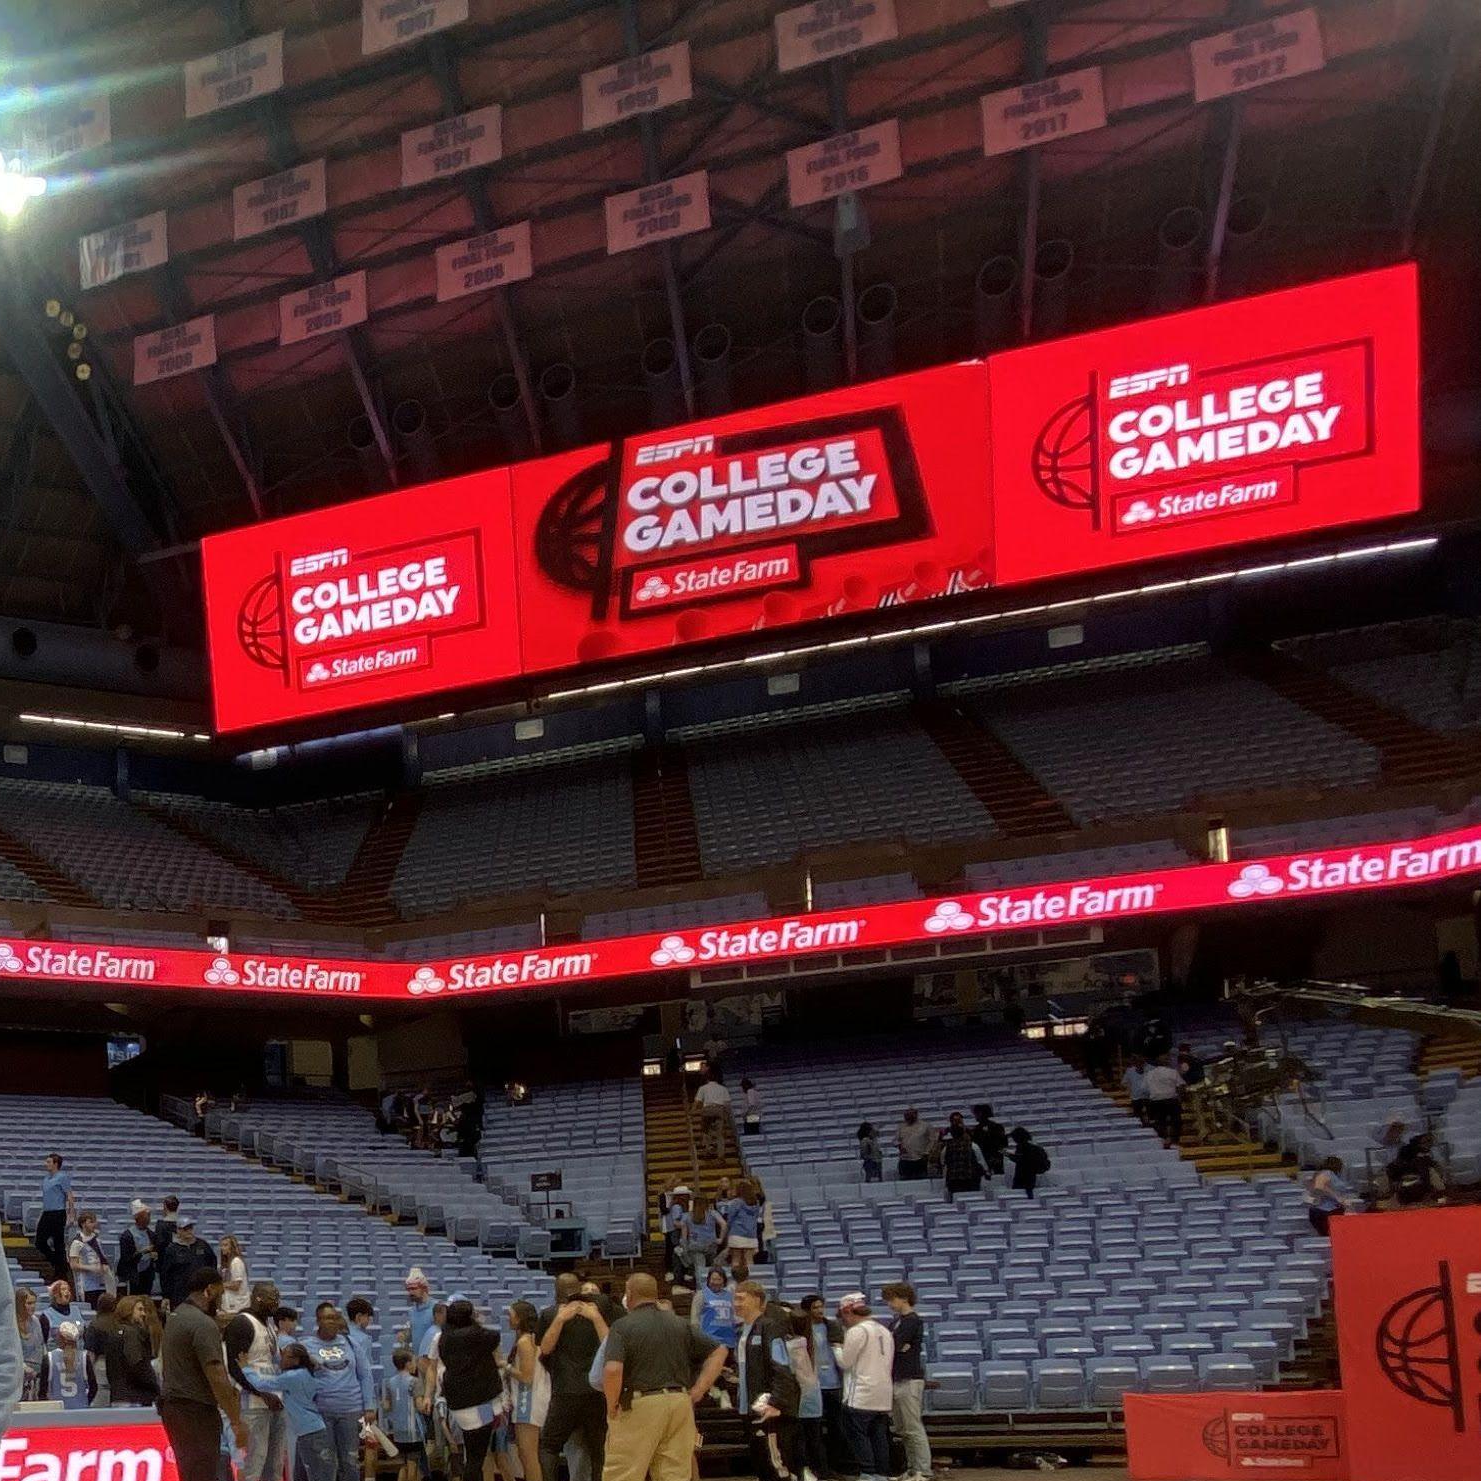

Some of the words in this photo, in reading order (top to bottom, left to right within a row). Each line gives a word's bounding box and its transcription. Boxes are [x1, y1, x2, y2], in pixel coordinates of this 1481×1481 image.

[1020, 112, 1068, 140] 2017
[1109, 363, 1190, 400] ESPN
[1108, 371, 1324, 444] COLLEGE
[635, 434, 714, 466] ESPN
[1109, 405, 1341, 480] GAMEDAY
[626, 439, 861, 510] COLLEGE
[624, 474, 877, 552] GAMEDAY
[290, 548, 349, 577] ESPN
[291, 557, 447, 615] COLLEGE
[294, 584, 460, 646] GAMEDAY
[1235, 1425, 1324, 1436] COLLEGE
[1236, 1439, 1330, 1450] GAMEDAY
